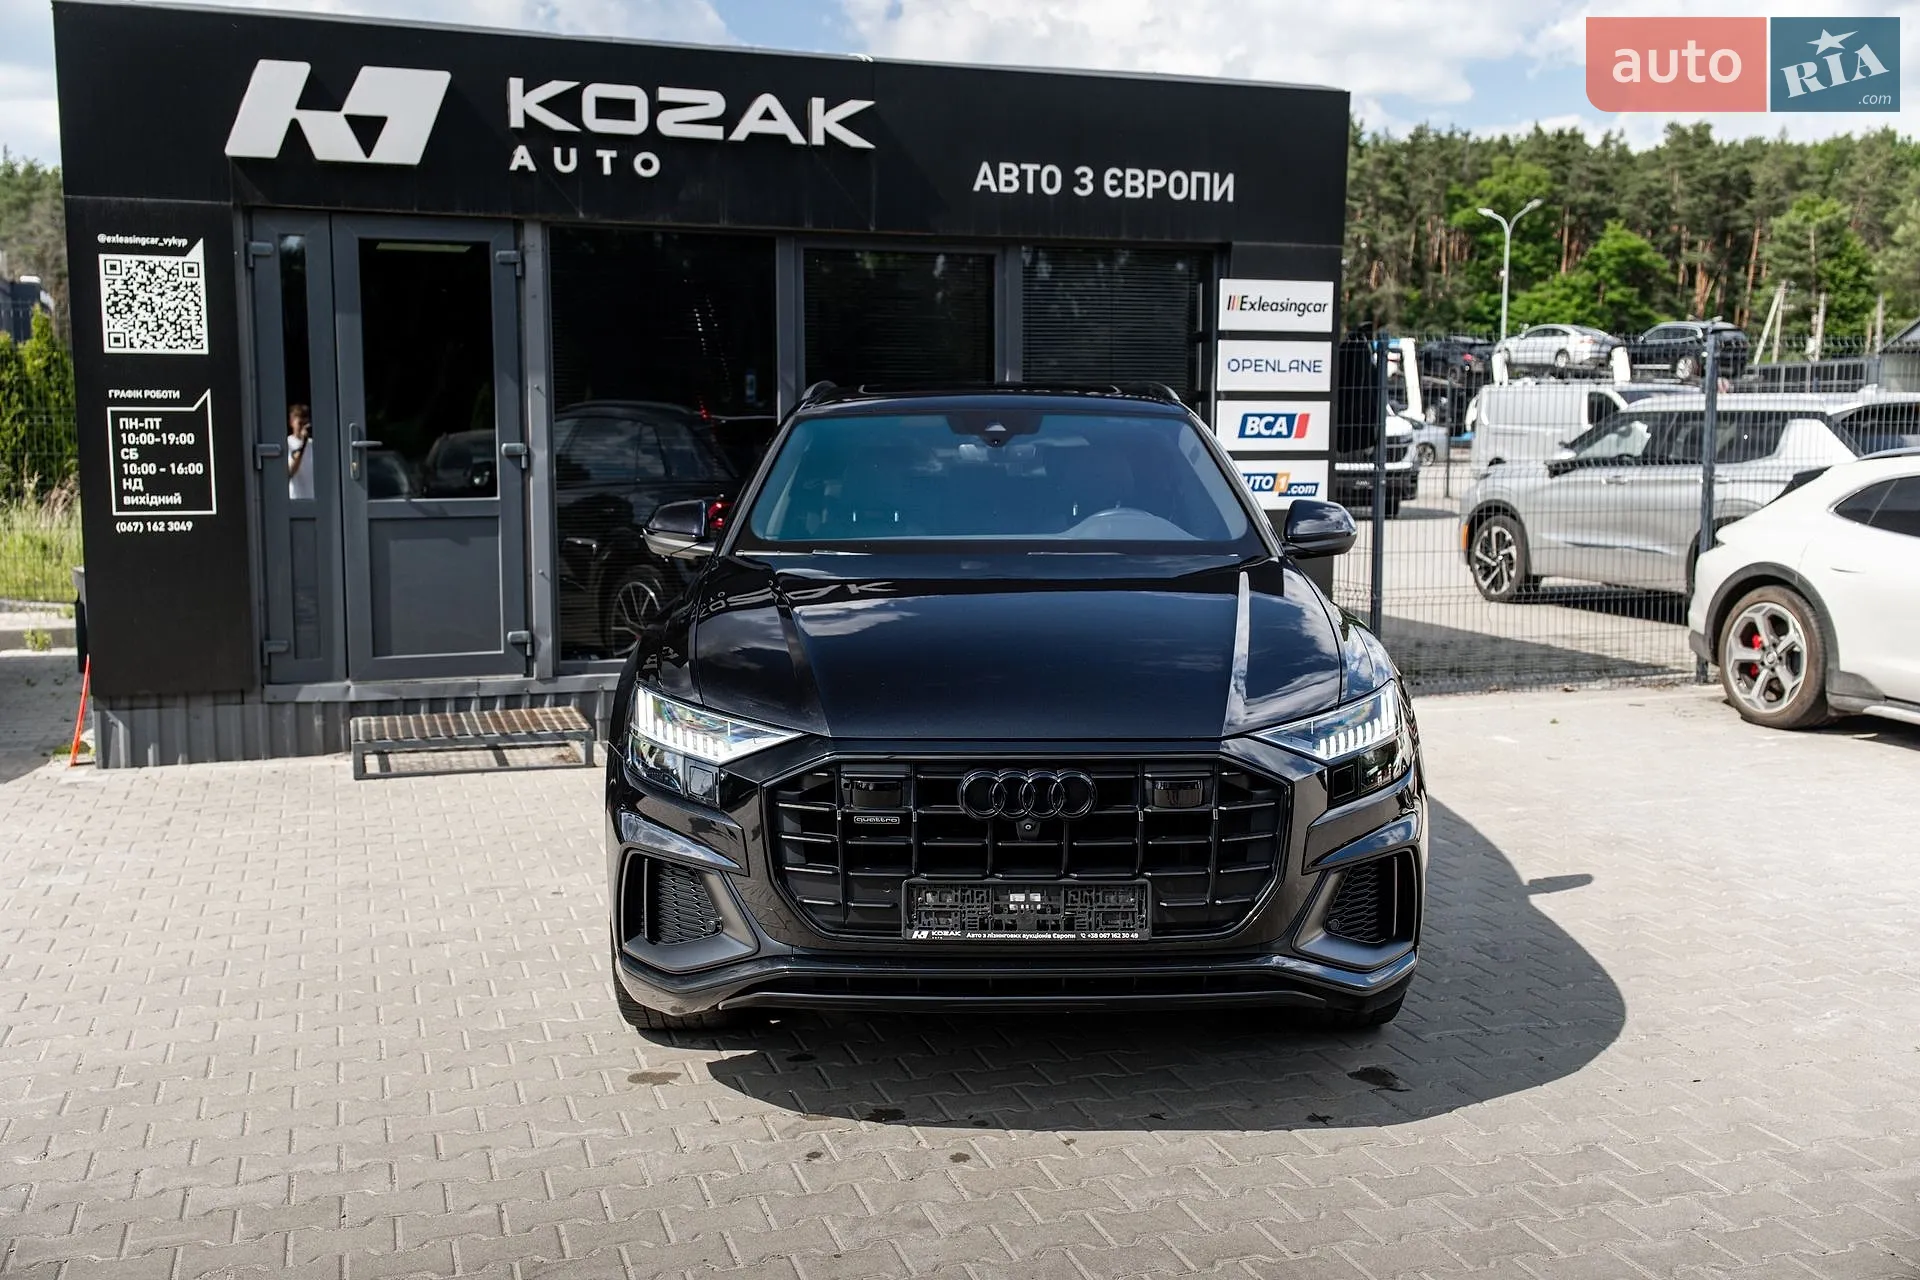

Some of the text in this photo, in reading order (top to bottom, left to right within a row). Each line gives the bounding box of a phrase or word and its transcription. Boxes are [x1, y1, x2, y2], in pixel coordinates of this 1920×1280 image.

[507, 77, 876, 150] KOZAK
[509, 145, 661, 178] AUTO
[972, 161, 1062, 195] АВТО
[1103, 167, 1235, 203] ЄВРОПИ
[1240, 294, 1328, 317] Exleasingcar
[1227, 358, 1323, 373] OPENLANE
[108, 389, 180, 399] ГРАФІК РОБОТИ
[119, 417, 162, 430] ПН-ПТ
[1244, 415, 1288, 437] BCA
[120, 432, 195, 445] 10:00-19:00
[120, 448, 139, 460] СБ
[122, 463, 157, 475] 10:00
[169, 463, 204, 475] 16:00
[122, 478, 144, 492] НД
[123, 493, 182, 507] вихідний
[115, 521, 193, 533] (067) 162 3049
